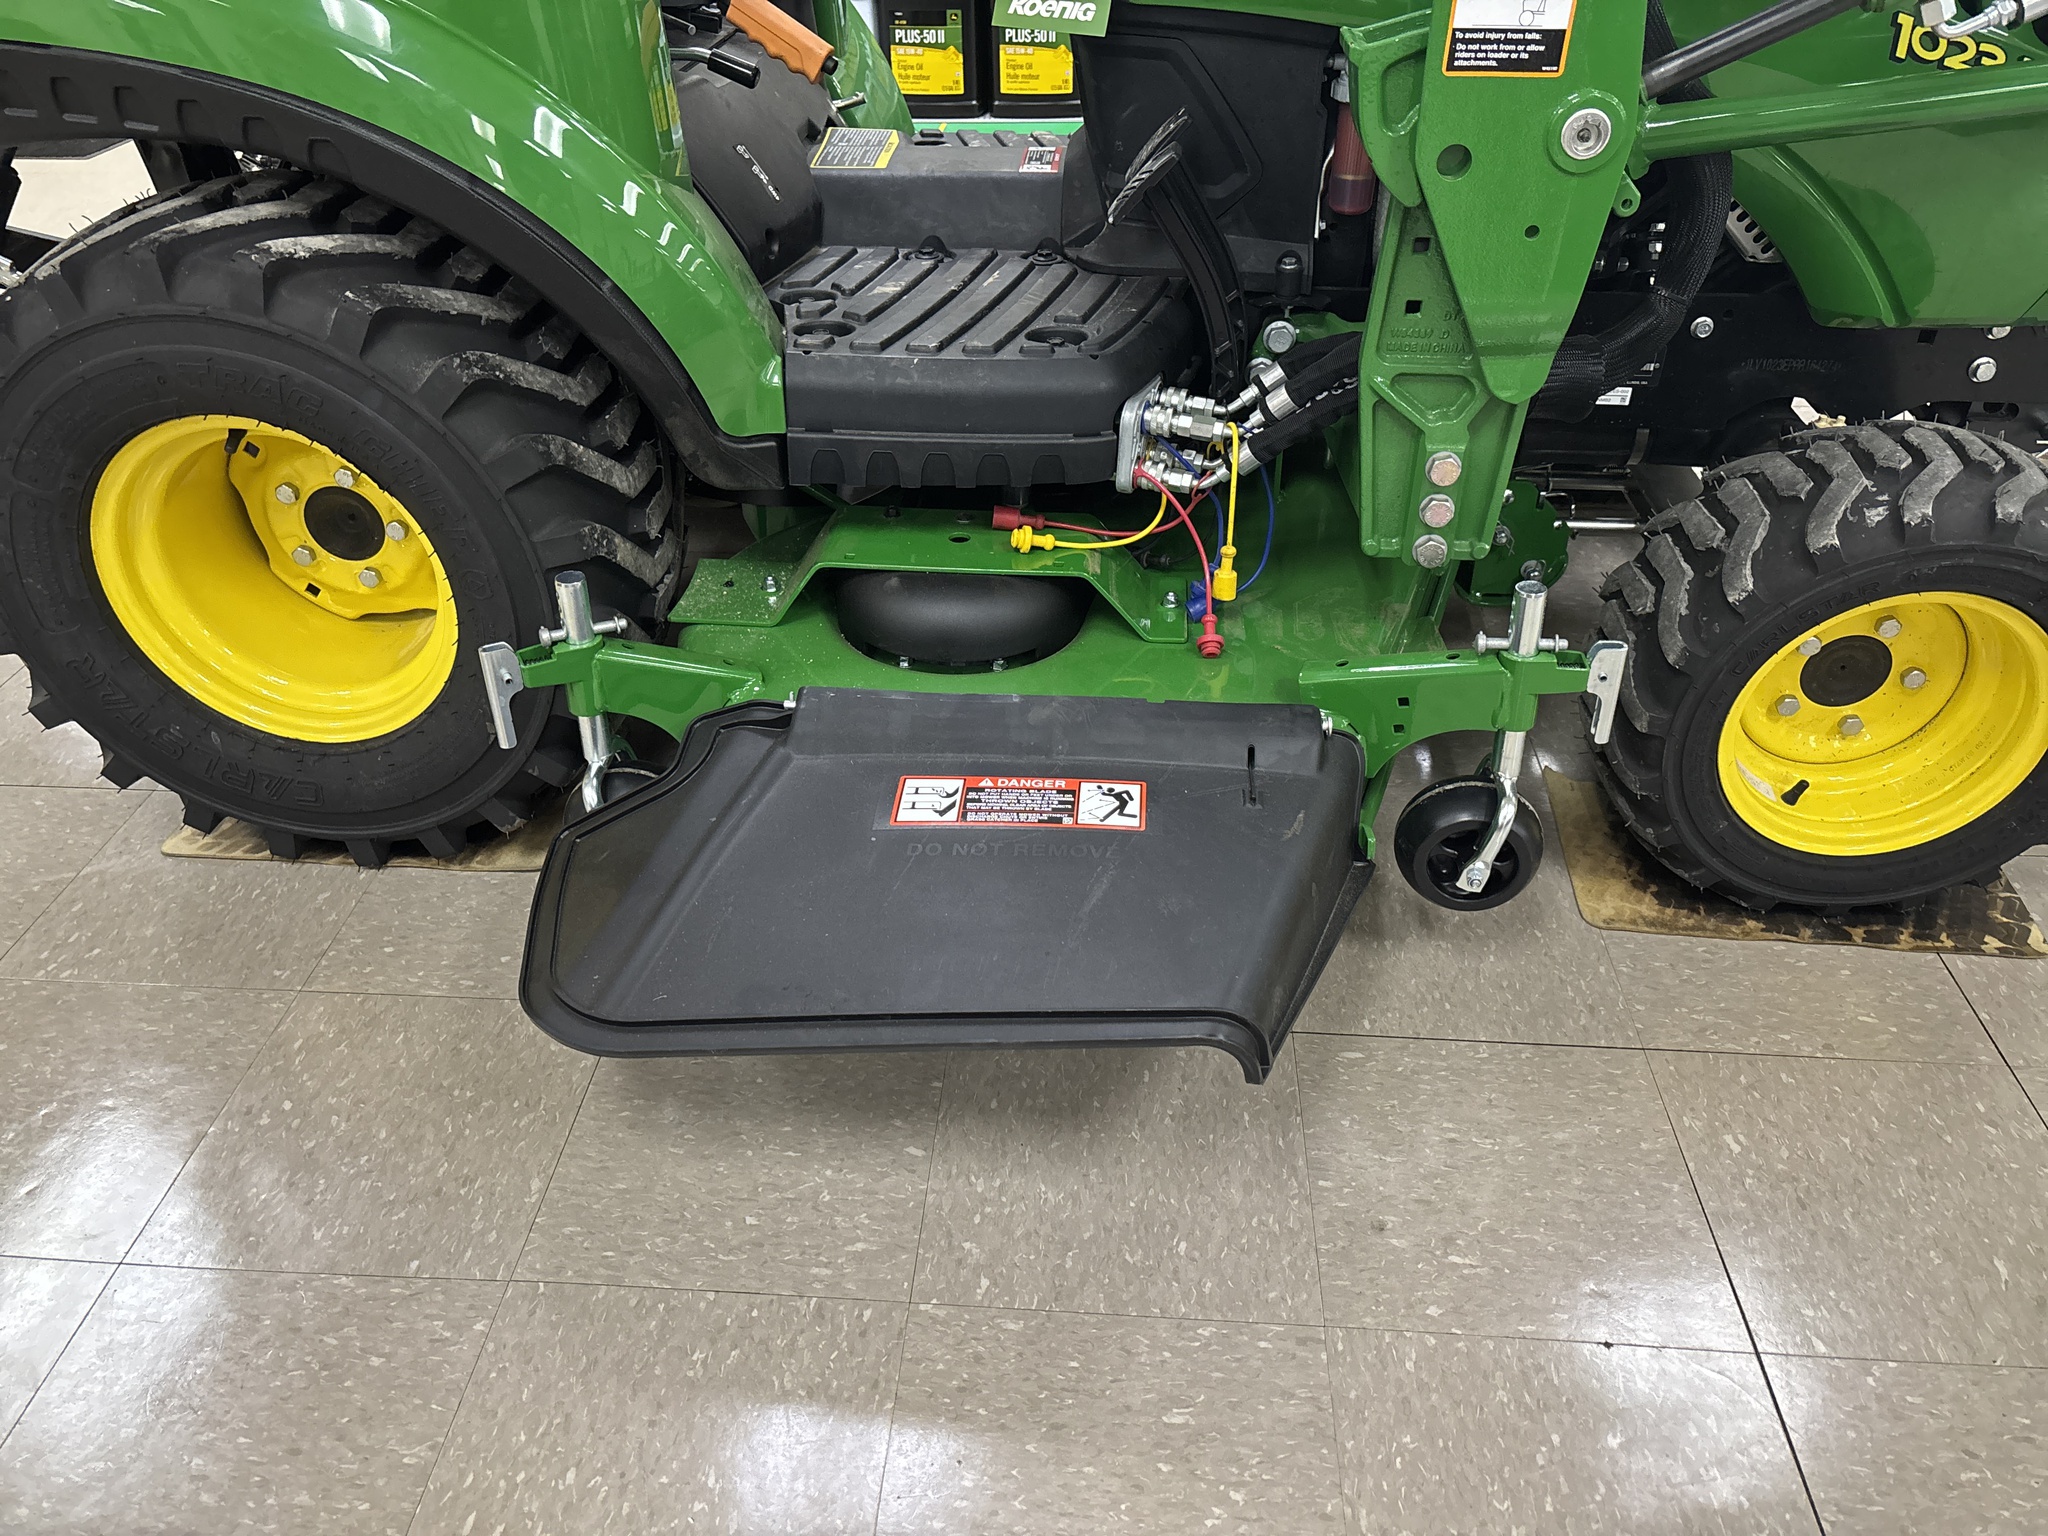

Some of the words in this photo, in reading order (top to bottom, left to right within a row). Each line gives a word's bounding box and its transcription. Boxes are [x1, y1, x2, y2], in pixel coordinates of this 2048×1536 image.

[895, 28, 936, 44] PLUS-50
[937, 29, 945, 44] II
[1005, 28, 1048, 43] PLUS-50
[1454, 31, 1464, 39] To
[1464, 31, 1484, 39] avoid
[1484, 31, 1506, 41] injury
[1455, 42, 1467, 50] Do
[1480, 43, 1498, 51] work
[1498, 43, 1516, 51] from
[897, 63, 915, 71] Engine
[915, 63, 924, 71] Oil
[1006, 62, 1025, 71] Engine
[1025, 62, 1033, 70] Oil
[1386, 341, 1418, 352] MADE
[1420, 342, 1432, 352] IN
[1433, 342, 1466, 353] CHINA
[176, 361, 325, 417] TRAC
[1729, 580, 1881, 677] CARLSTAR
[65, 652, 325, 807] CARLSTAR
[997, 778, 1067, 788] DANGER
[906, 842, 943, 857] DO
[951, 842, 1004, 857] NOT
[1013, 842, 1120, 860] REMOVE
